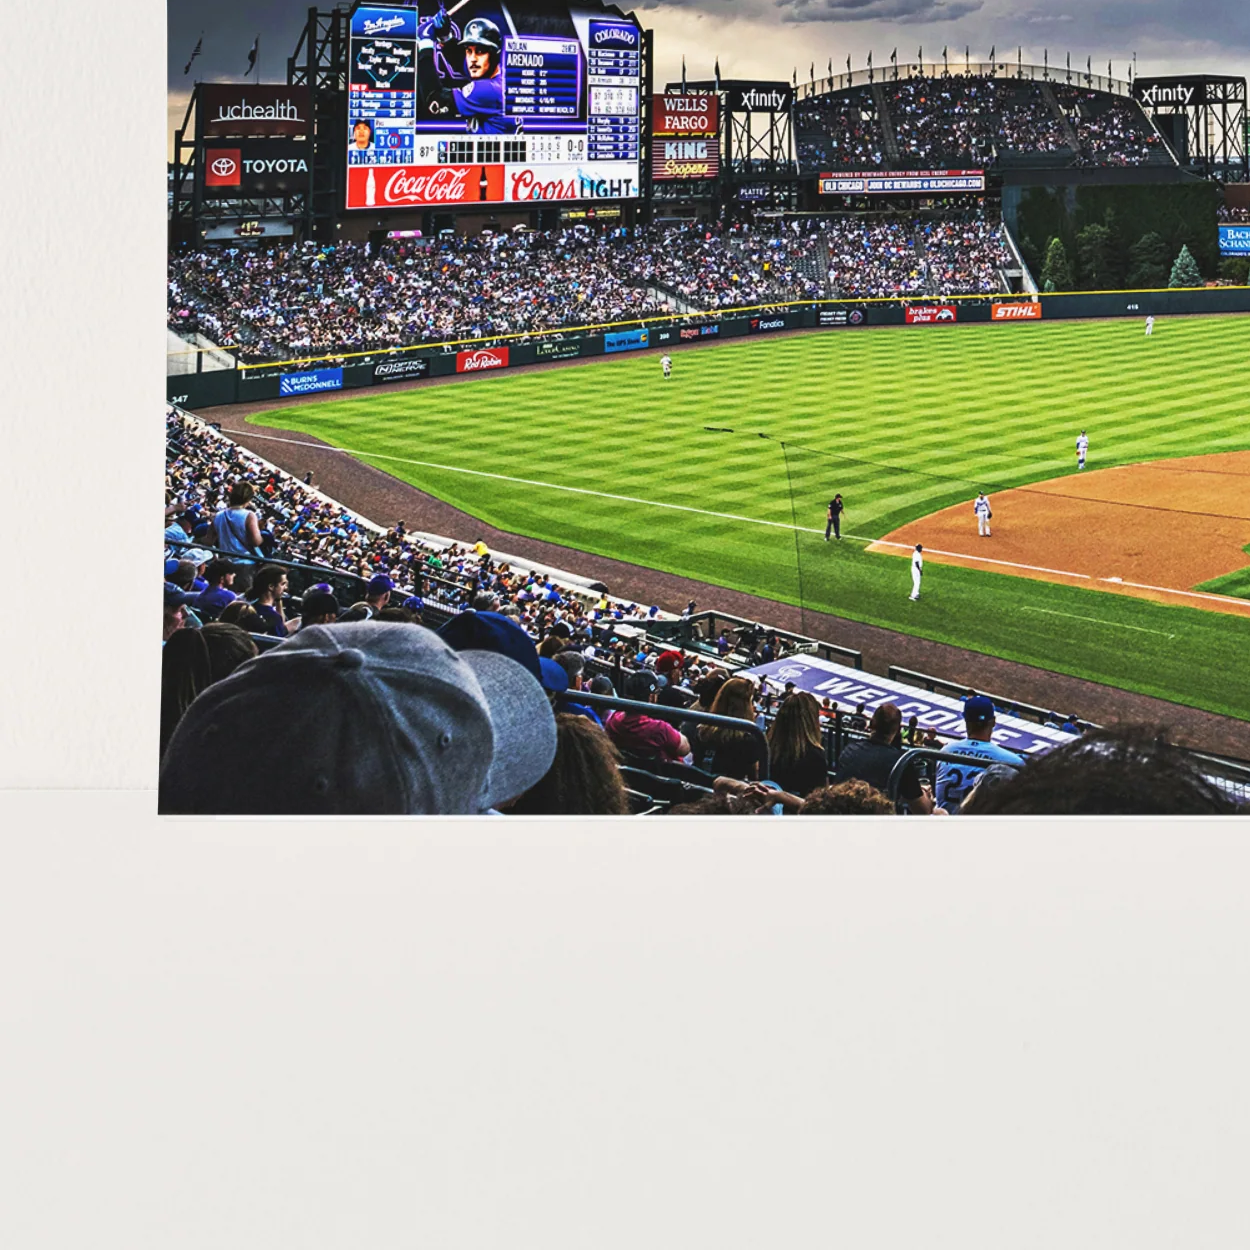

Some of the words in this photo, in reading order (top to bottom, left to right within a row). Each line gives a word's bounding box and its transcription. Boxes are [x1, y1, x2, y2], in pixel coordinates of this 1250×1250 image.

[594, 28, 635, 45] COLORADO
[507, 41, 528, 51] NOLAN
[506, 54, 544, 67] ARENADO
[741, 88, 787, 110] xfinity
[1141, 84, 1194, 106] xfinity
[219, 98, 298, 120] uchealth
[663, 98, 708, 112] WELLS
[664, 115, 708, 130] FARGO
[664, 142, 708, 160] KING
[242, 159, 309, 173] TOYOTA
[384, 168, 471, 203] Coca-Cola
[511, 169, 577, 202] Coors
[580, 178, 633, 198] LIGHT
[740, 188, 764, 196] PLATTE
[908, 308, 938, 316] brakes
[912, 315, 931, 323] plus
[995, 306, 1036, 318] STIHL
[759, 319, 785, 330] Fanatics
[463, 357, 480, 370] Red
[480, 356, 503, 368] Robin
[290, 375, 318, 386] BURNS
